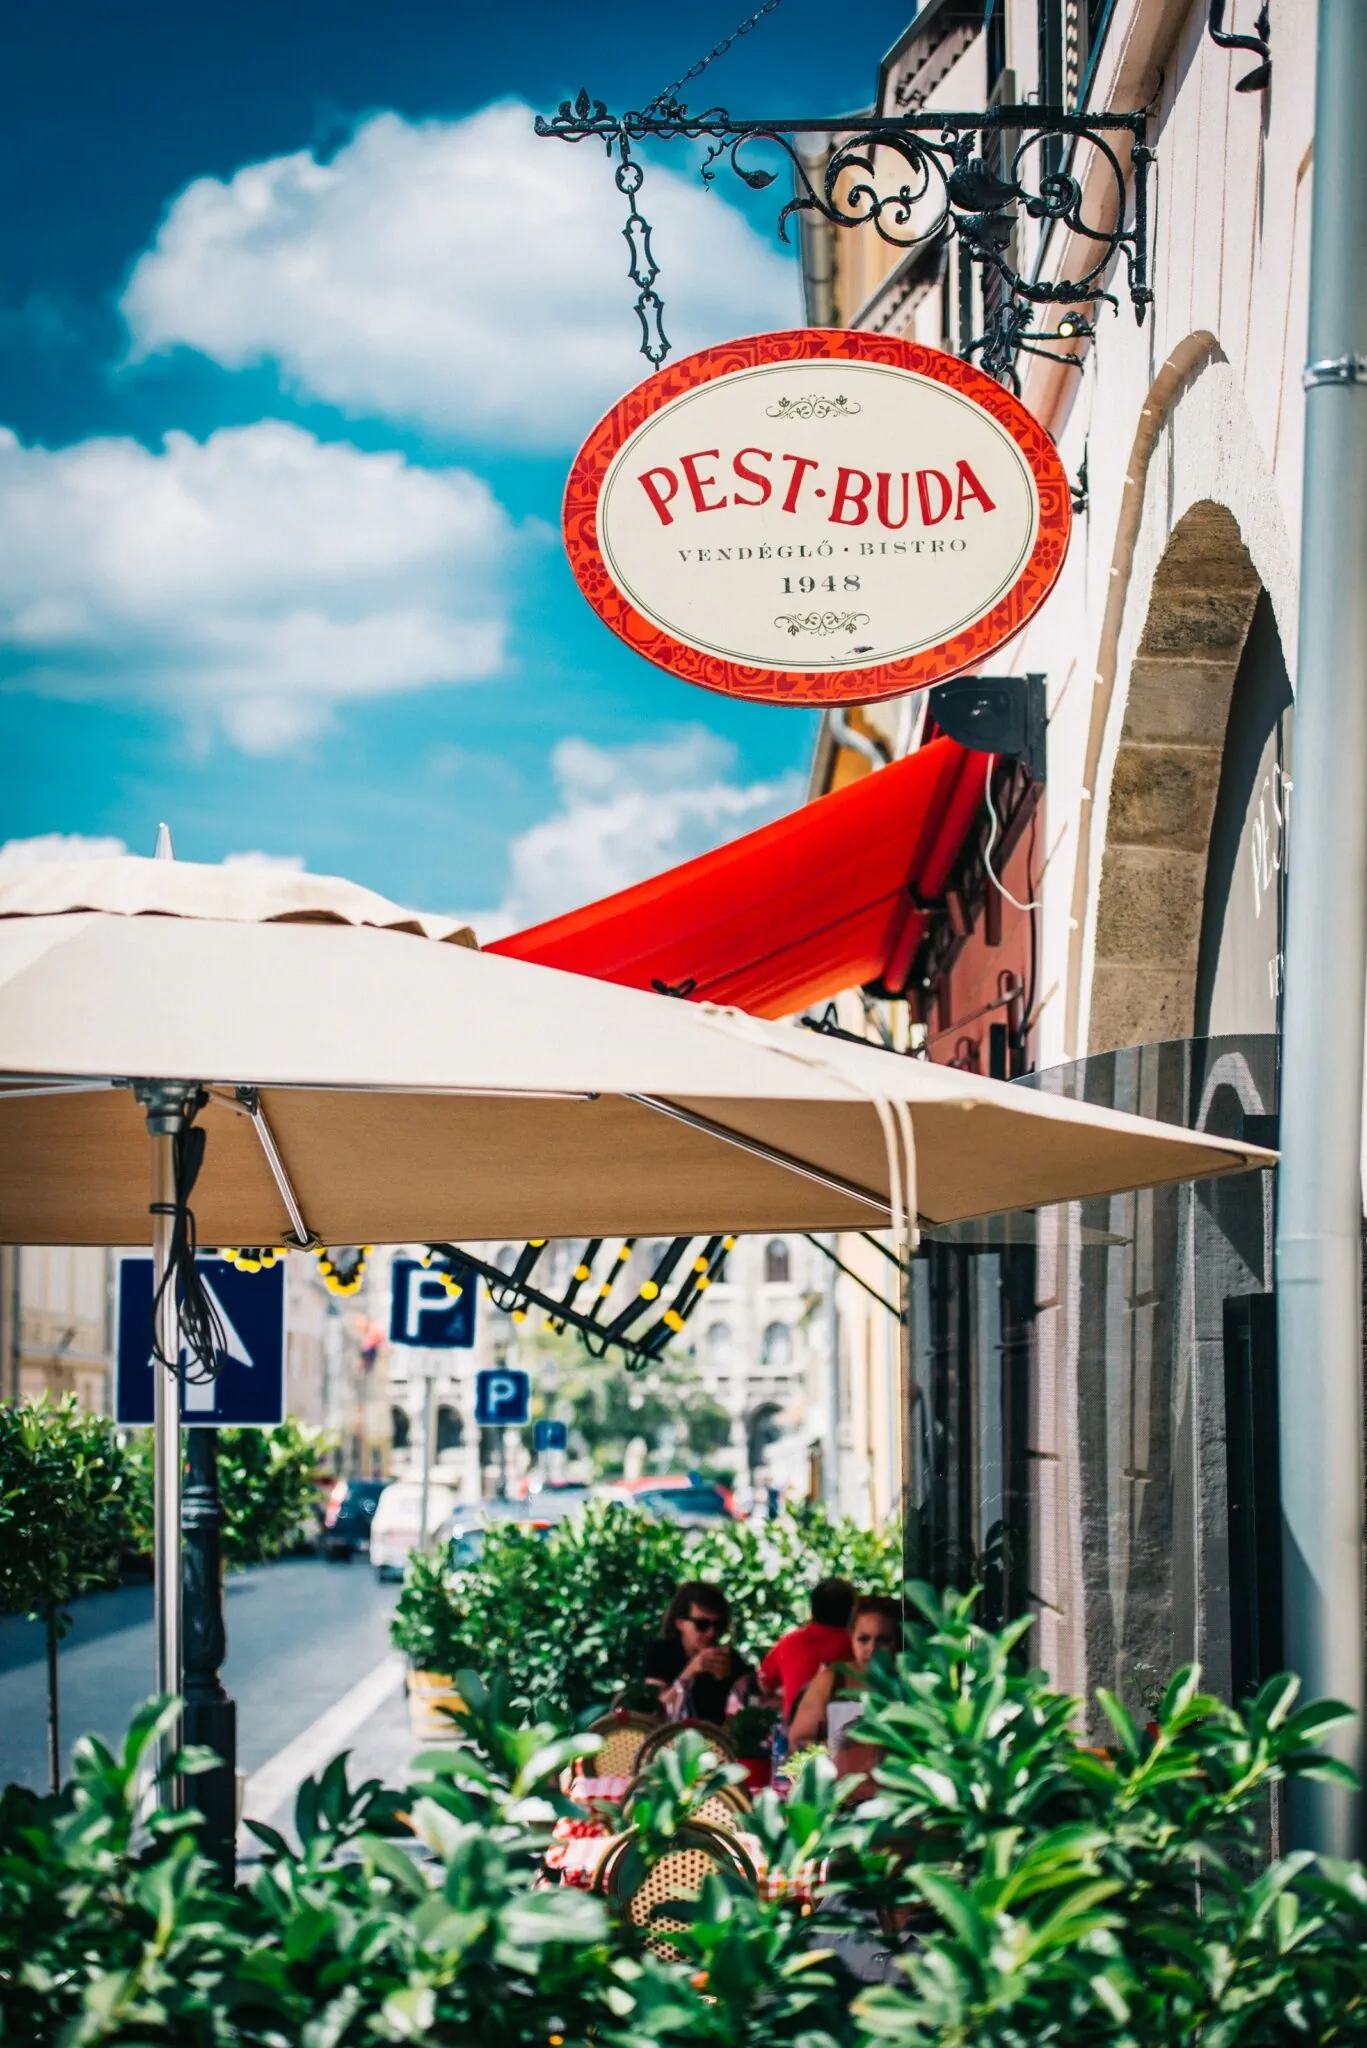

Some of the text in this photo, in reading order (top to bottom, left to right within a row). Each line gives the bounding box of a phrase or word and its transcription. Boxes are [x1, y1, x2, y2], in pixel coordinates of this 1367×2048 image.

[678, 539, 967, 562] VENDÉGLŐ BISTRO
[780, 575, 861, 594] 1948
[406, 1269, 462, 1338] P
[486, 1377, 516, 1414] P
